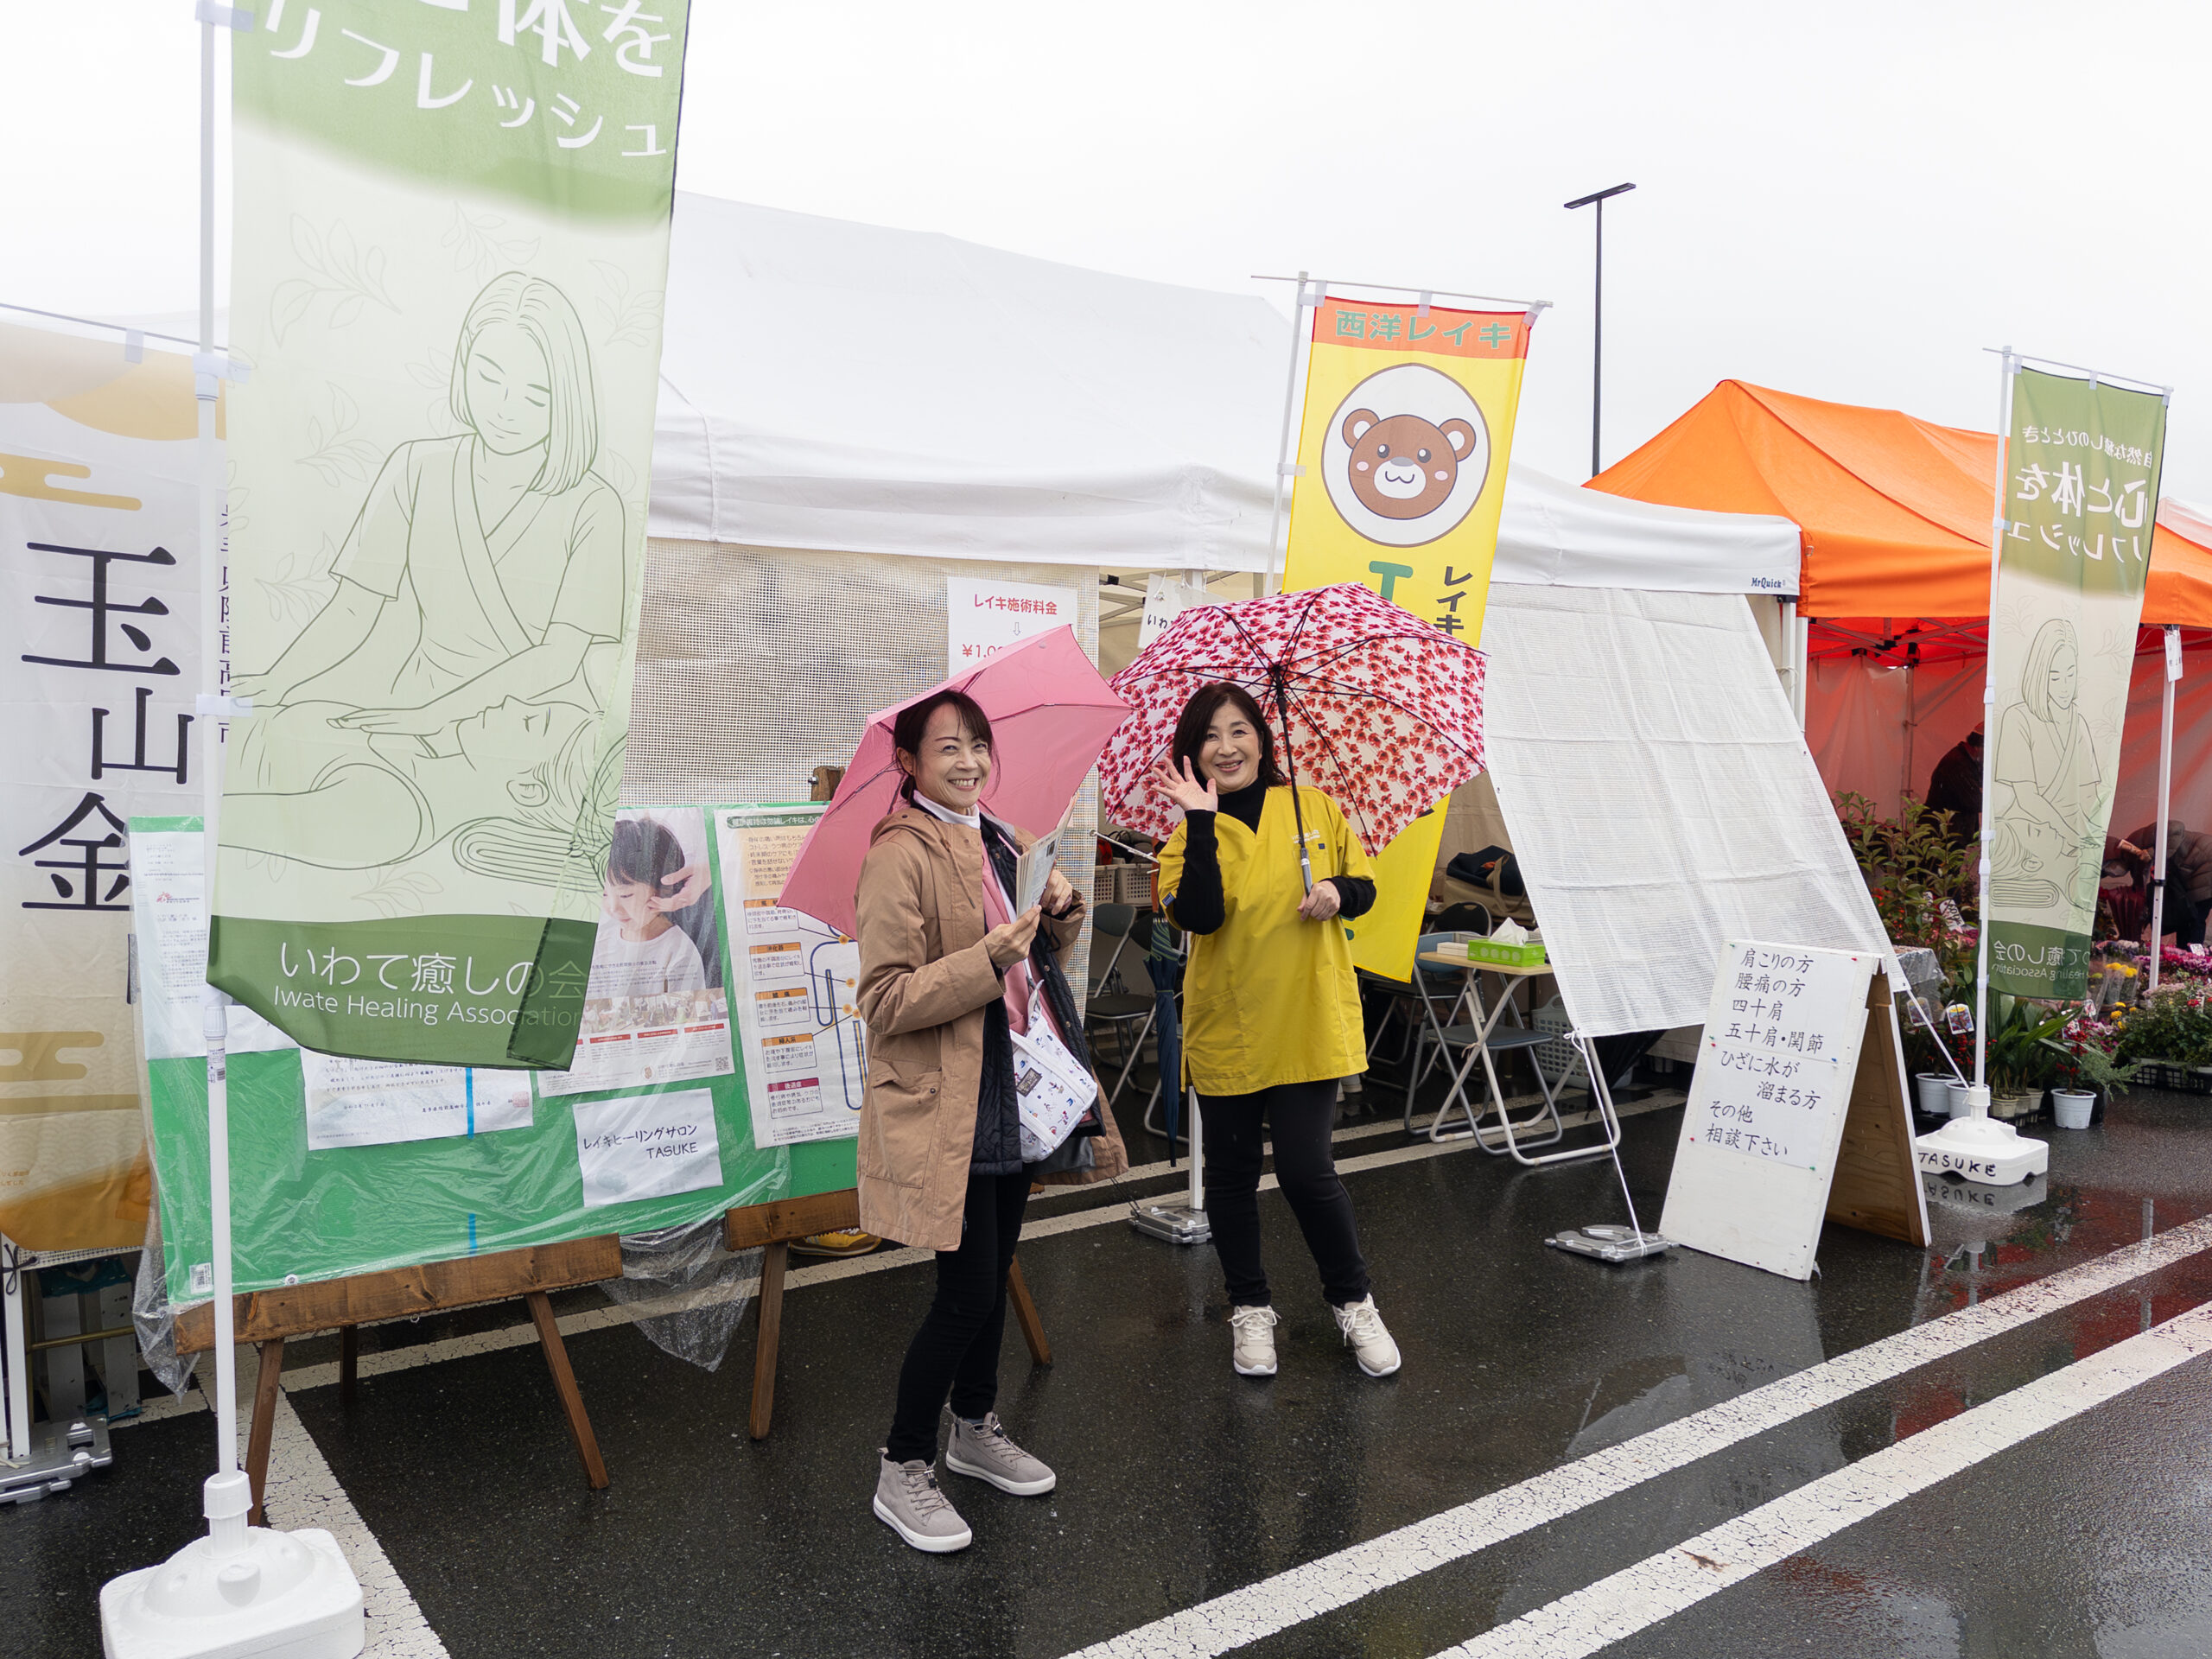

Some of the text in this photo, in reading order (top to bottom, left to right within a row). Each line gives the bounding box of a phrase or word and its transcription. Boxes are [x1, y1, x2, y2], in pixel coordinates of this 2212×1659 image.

[420, 0, 671, 78] 体を
[264, 0, 667, 156] リフレッシュ
[1336, 310, 1511, 349] 西洋レイキ
[974, 594, 1058, 615] レイキ施術料金
[1147, 614, 1173, 629] いわ
[19, 543, 194, 1004] 玉山金
[281, 942, 586, 1000] いわて癒しの会
[1740, 948, 1814, 974] 肩こりの方
[1735, 973, 1806, 997] 腰痛の方
[274, 985, 338, 1013] Iwate
[347, 995, 438, 1025] Healing
[1732, 999, 1783, 1021] 四十肩
[1725, 1023, 1824, 1054] 五十肩・関節
[1721, 1050, 1798, 1077] ひざに水が
[1757, 1081, 1821, 1109] 溜まる方
[1709, 1100, 1753, 1124] その他
[583, 1124, 698, 1150] レイキヒーリングサロン
[1706, 1123, 1788, 1157] 相談下さい
[646, 1142, 698, 1160] TASUKE
[1917, 1153, 1996, 1177] TASUKE
